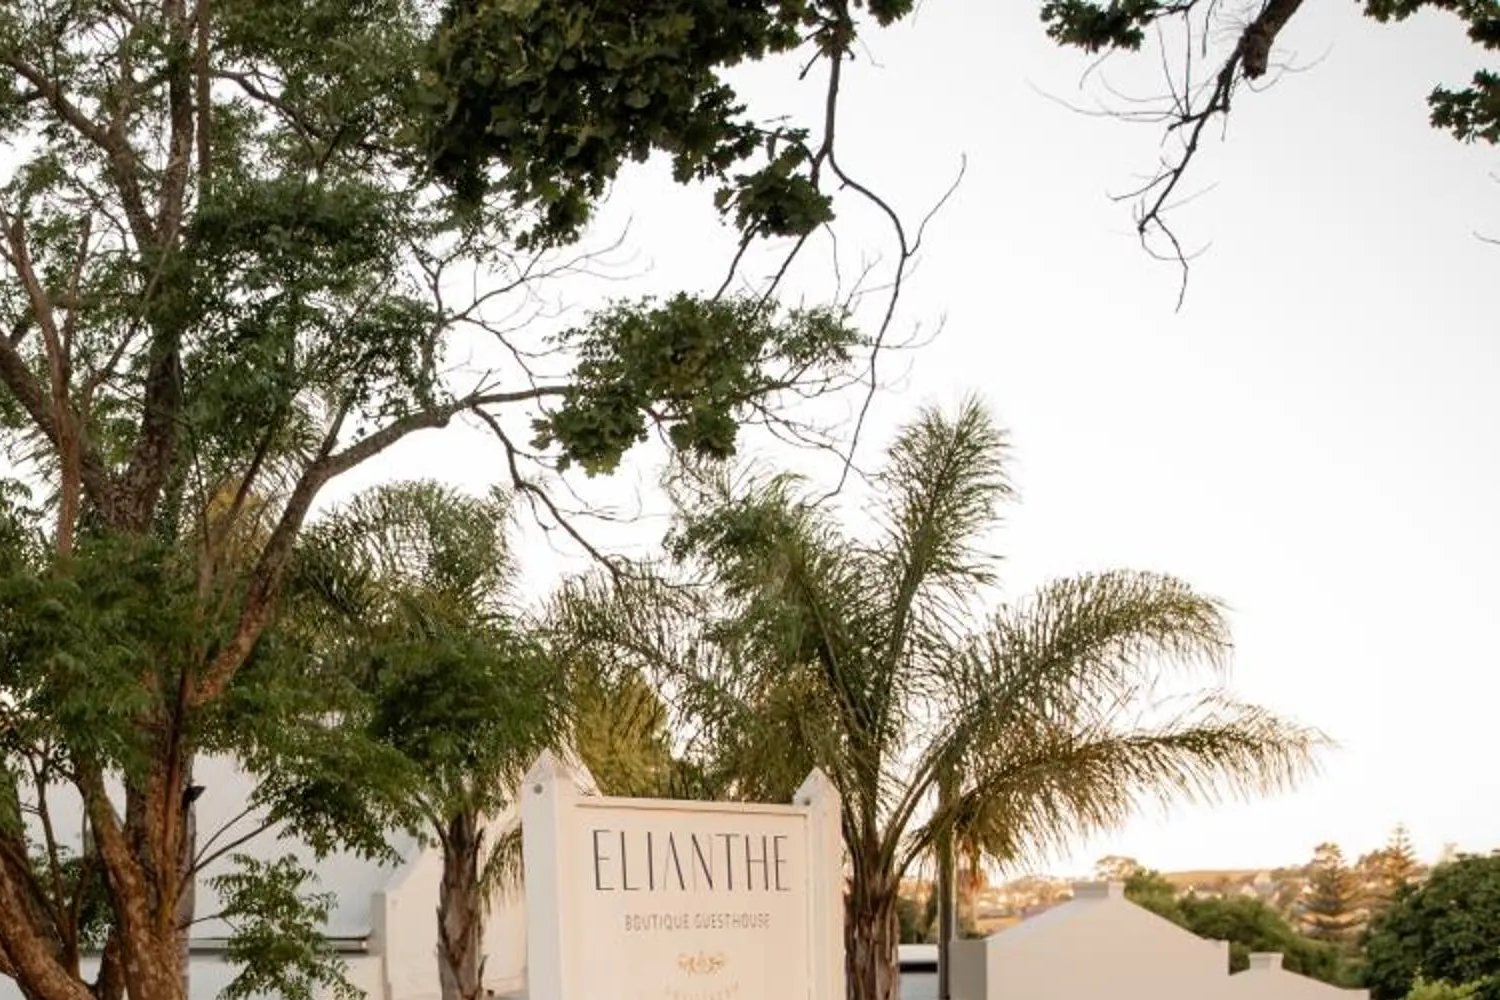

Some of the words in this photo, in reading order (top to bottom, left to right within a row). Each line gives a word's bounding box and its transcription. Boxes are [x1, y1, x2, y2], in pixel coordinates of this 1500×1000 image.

[593, 829, 791, 892] ELIANTHE
[624, 914, 690, 931] BOUTIQUE
[695, 912, 772, 929] GUESTHOUSE
